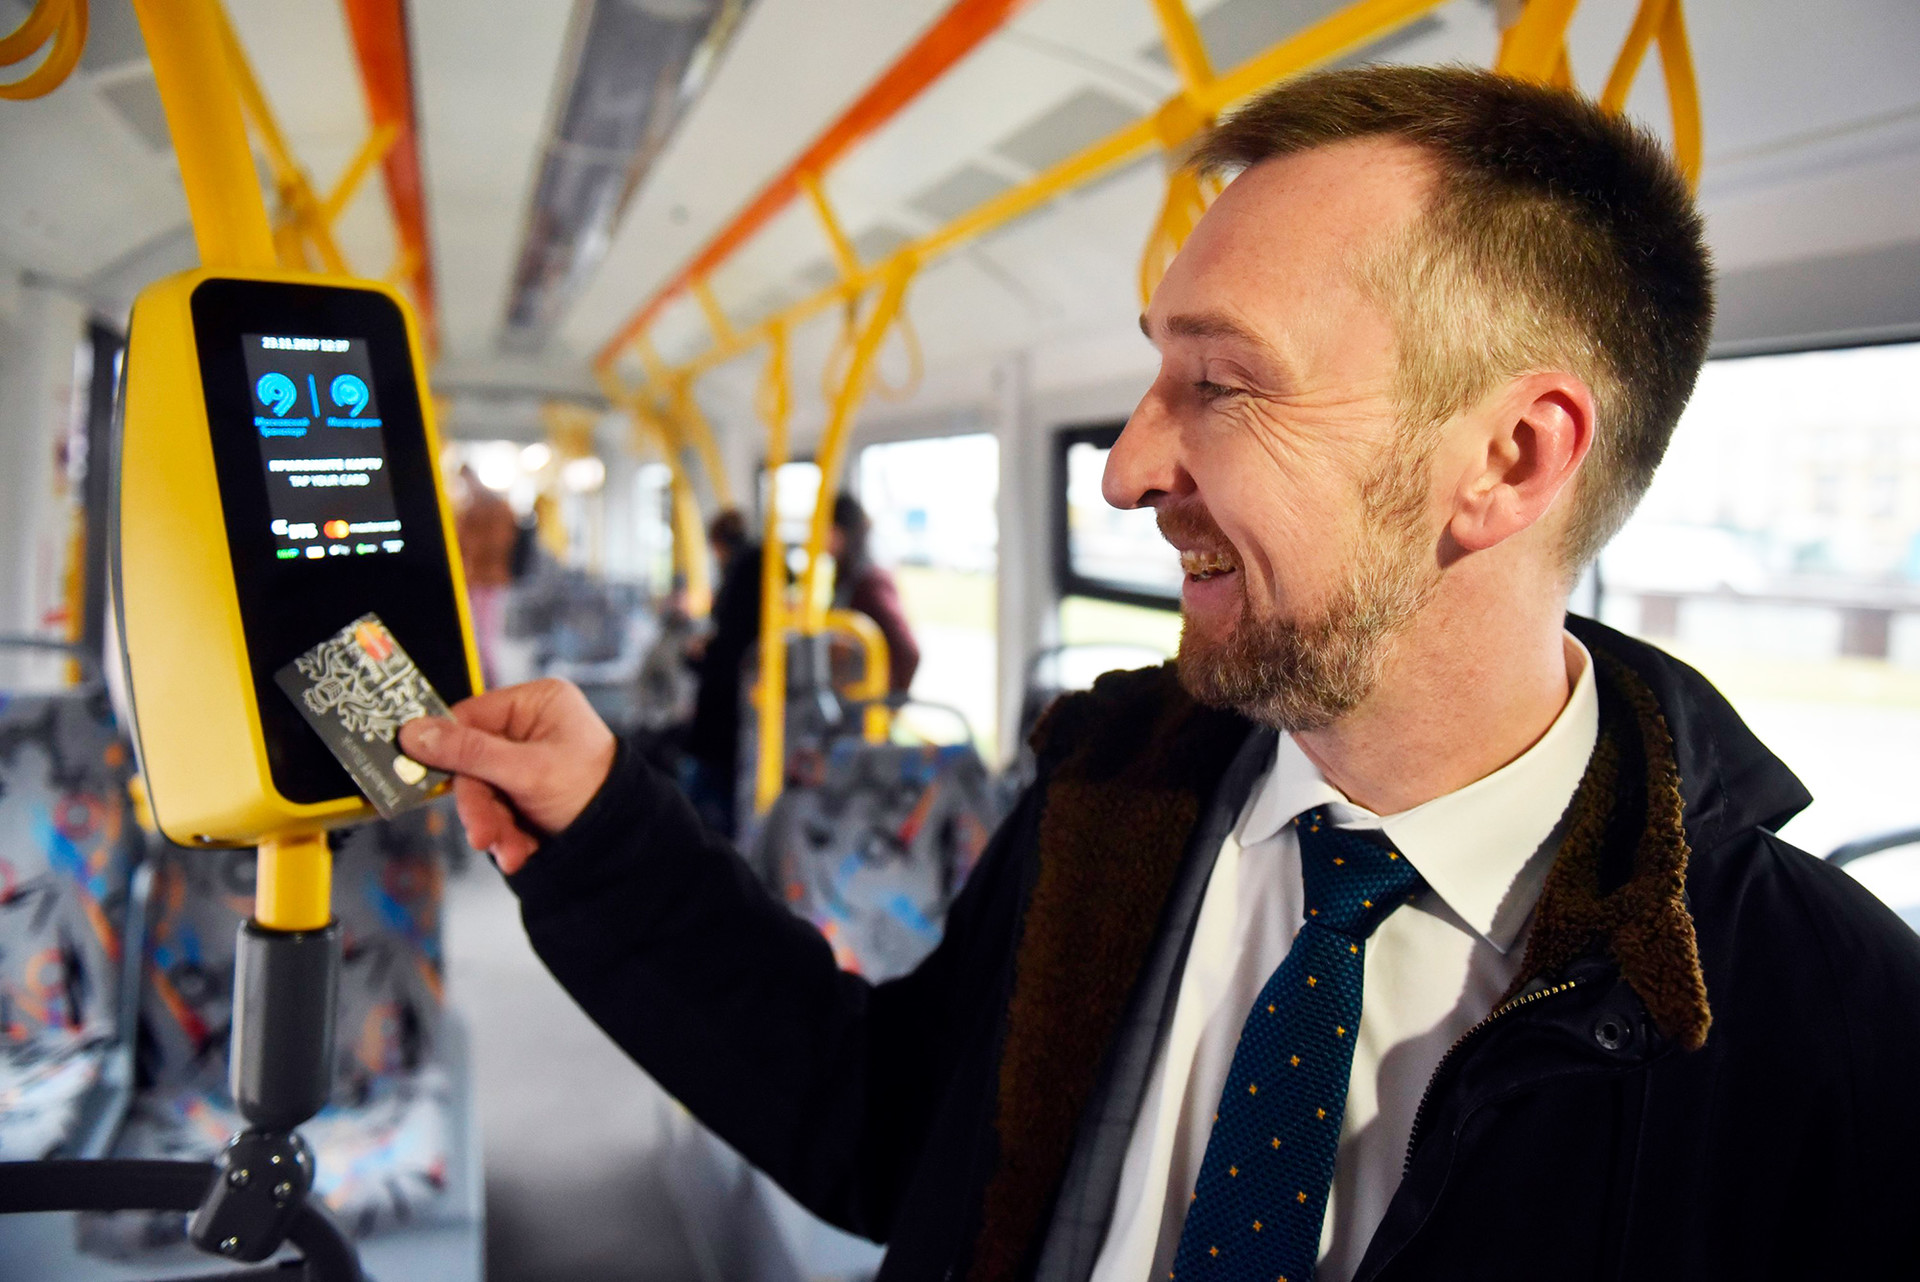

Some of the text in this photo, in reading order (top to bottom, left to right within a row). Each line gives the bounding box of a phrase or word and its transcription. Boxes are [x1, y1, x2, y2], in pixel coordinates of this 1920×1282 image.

[289, 473, 370, 487] TAP YOUR CARD
